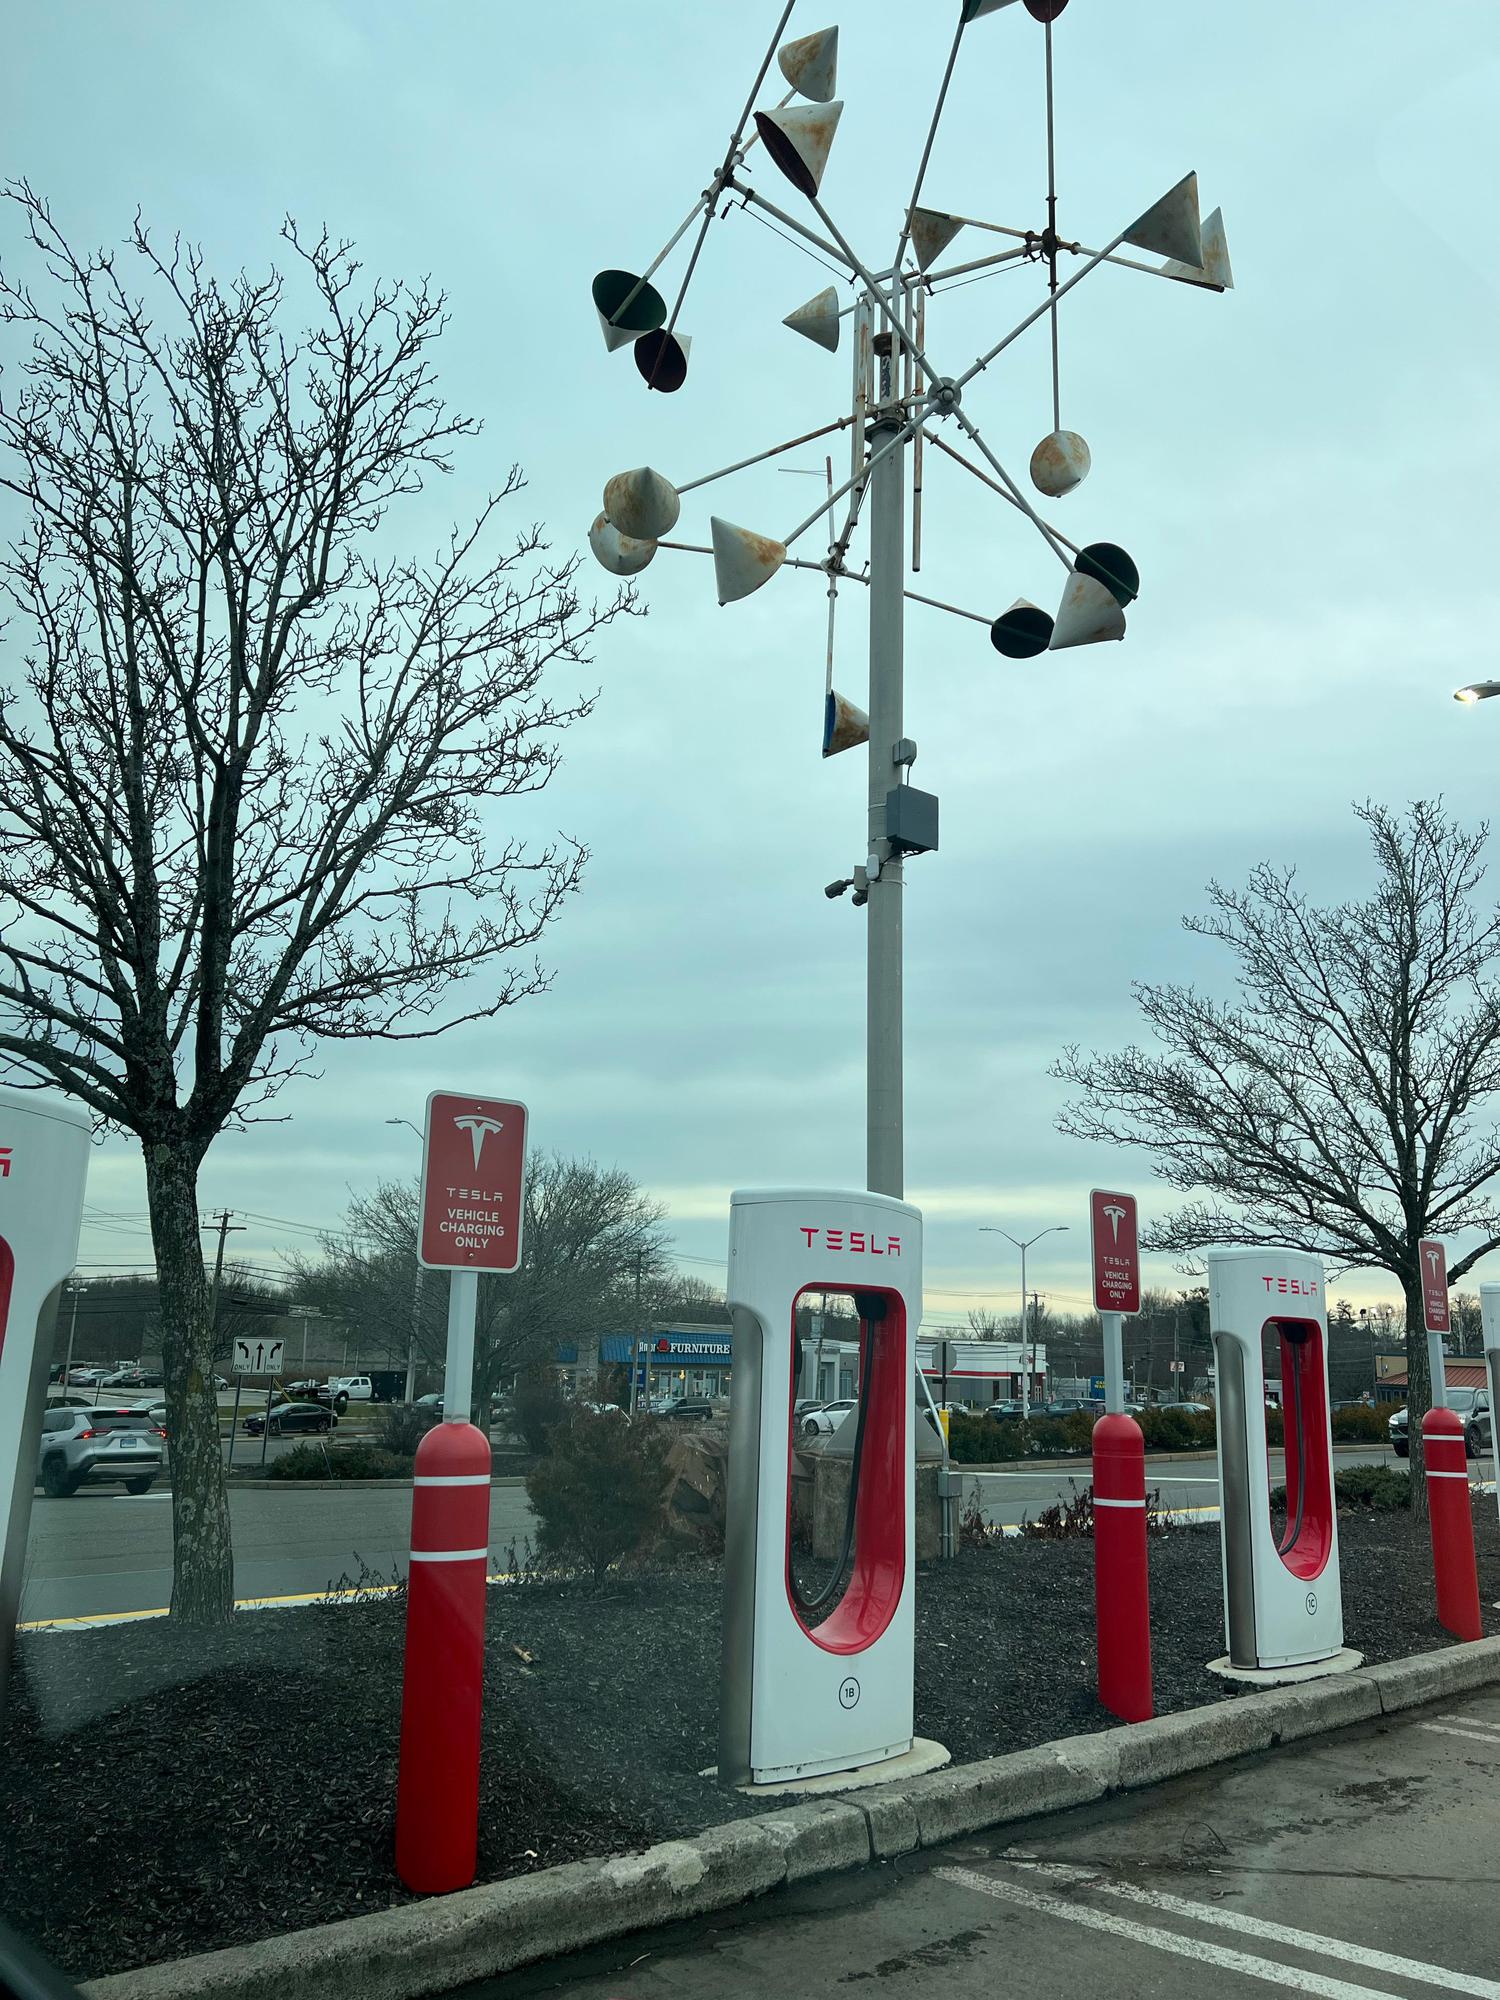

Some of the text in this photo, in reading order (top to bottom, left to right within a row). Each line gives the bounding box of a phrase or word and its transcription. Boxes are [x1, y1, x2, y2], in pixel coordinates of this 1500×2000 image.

[446, 1187, 503, 1203] TESLA
[447, 1208, 499, 1223] VEHICLE
[439, 1221, 505, 1237] CHARGING
[455, 1236, 489, 1249] ONLY
[799, 1227, 901, 1257] TESLA
[1103, 1256, 1130, 1266] TESLA
[1104, 1271, 1129, 1281] VEHICLE
[1102, 1280, 1132, 1290] CHARGING
[1262, 1276, 1318, 1296] TESLA
[1109, 1290, 1126, 1299] ONLY
[670, 1342, 731, 1354] FURNITURE
[234, 1363, 250, 1371] ONLY
[1308, 1598, 1315, 1608] 1C
[845, 1687, 855, 1698] 1B
